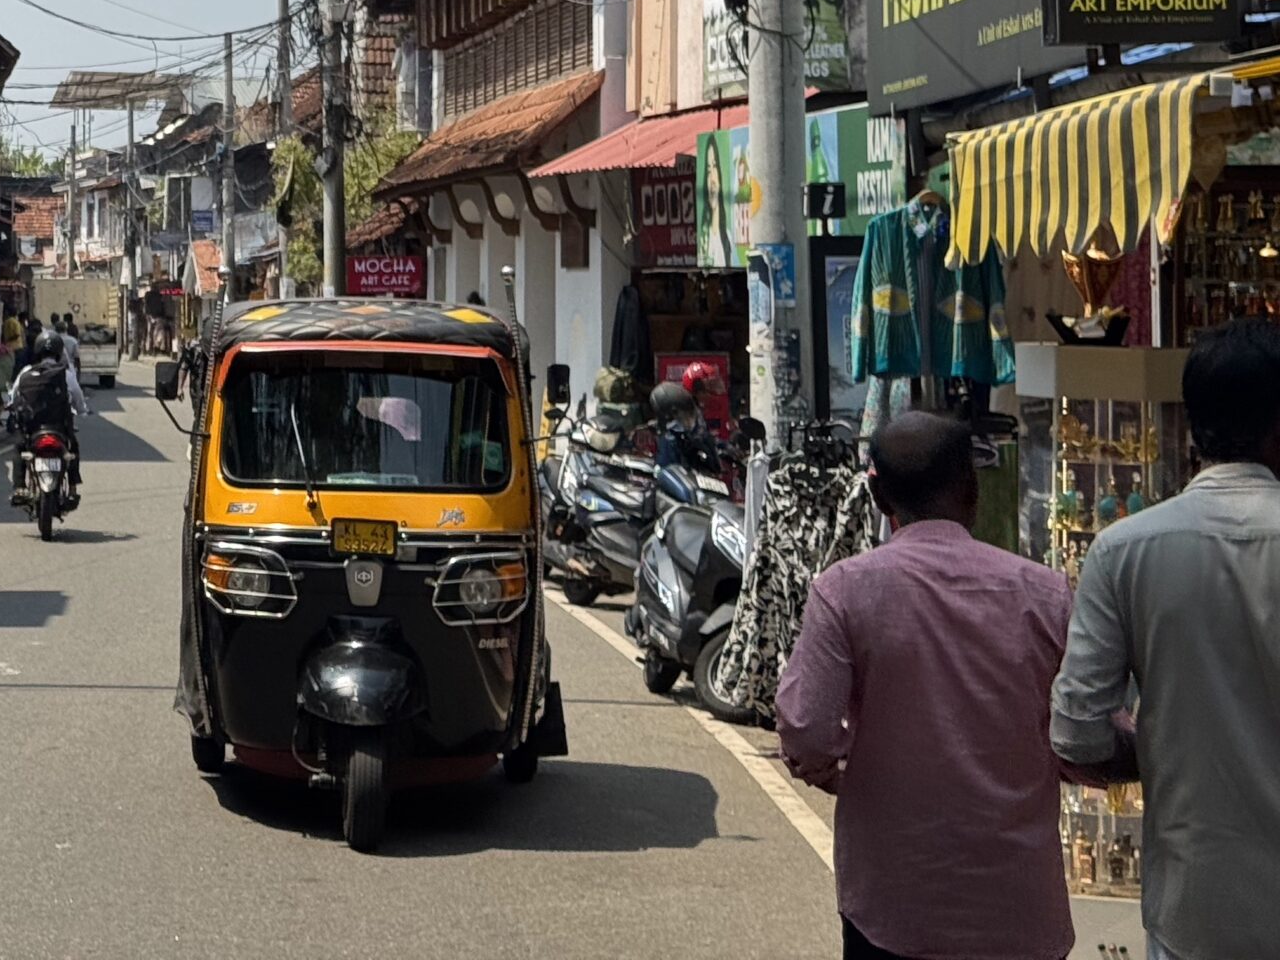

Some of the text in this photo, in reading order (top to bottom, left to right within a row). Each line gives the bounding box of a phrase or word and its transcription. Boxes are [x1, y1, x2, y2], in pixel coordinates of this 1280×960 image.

[804, 61, 830, 78] AGS
[354, 258, 416, 273] MOCHA
[360, 274, 411, 286] ART CAFE
